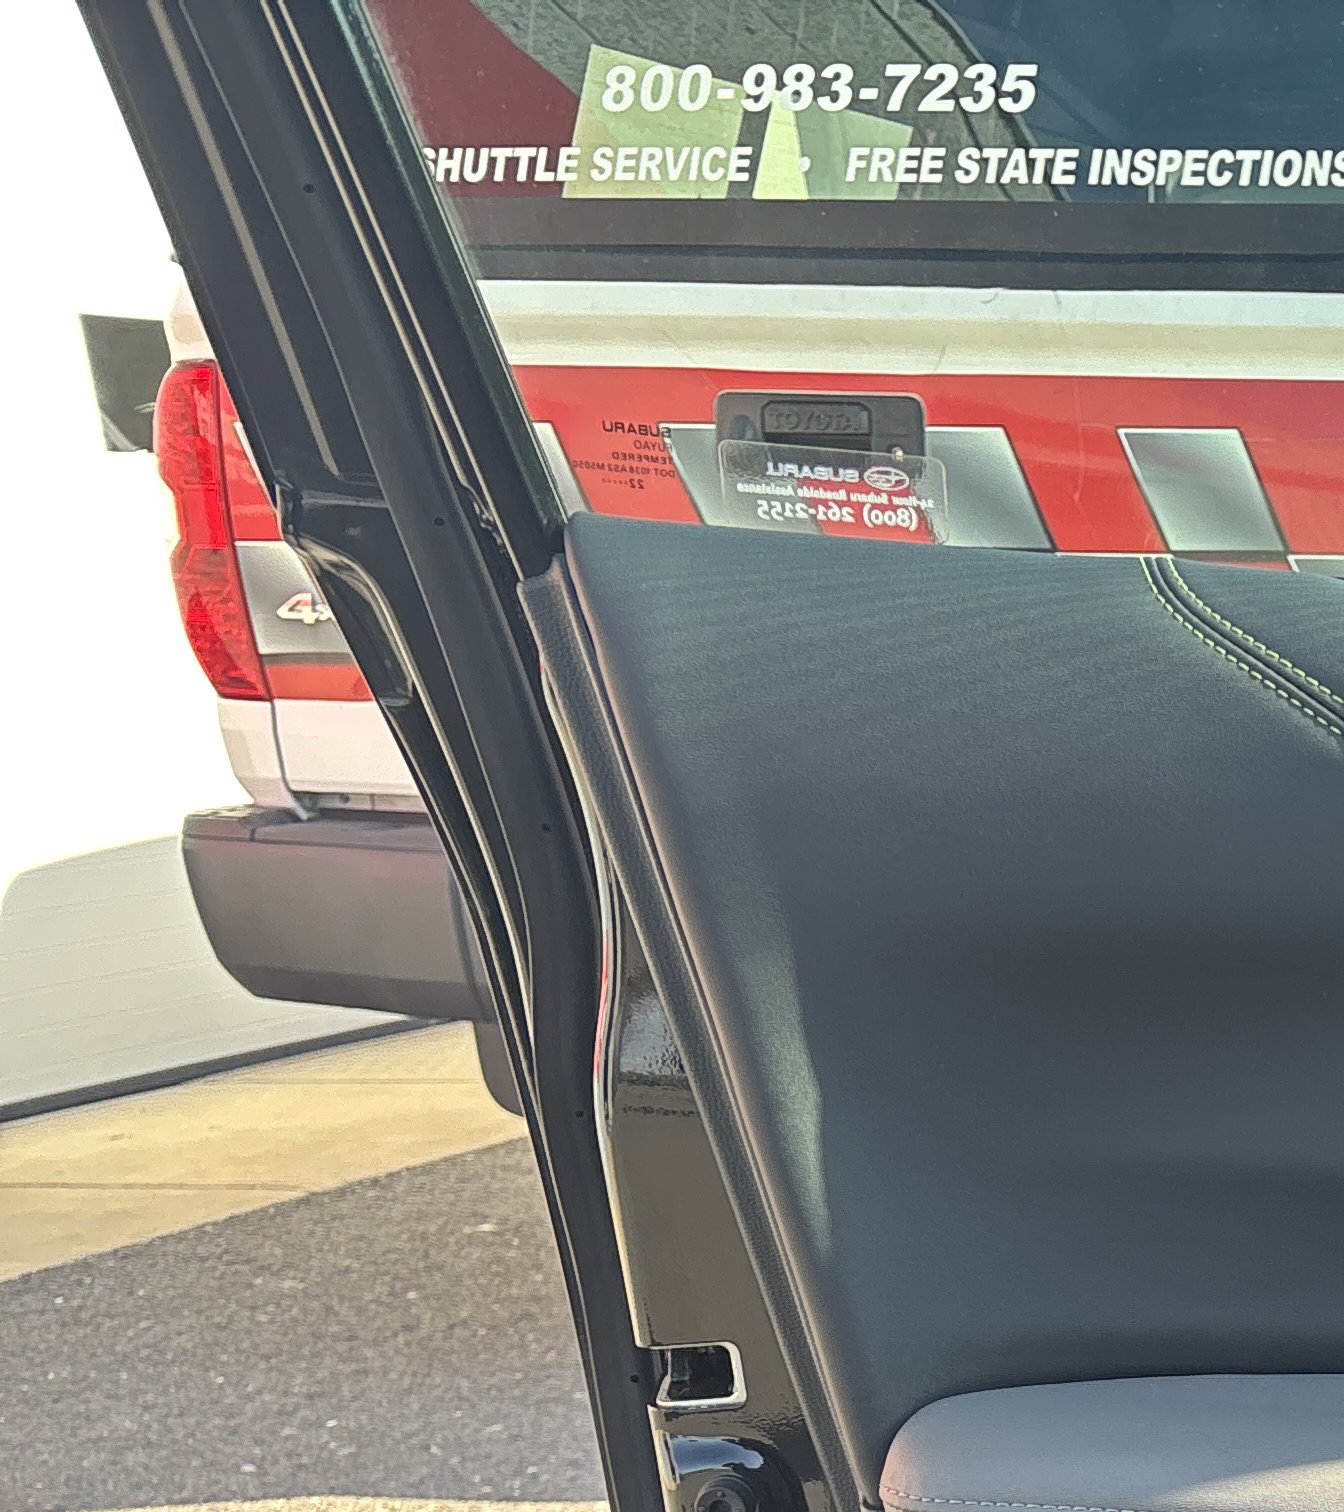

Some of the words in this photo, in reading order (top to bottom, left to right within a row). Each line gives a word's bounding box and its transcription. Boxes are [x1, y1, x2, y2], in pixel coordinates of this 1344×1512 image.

[601, 63, 1038, 113] 800-983-7235
[422, 146, 581, 184] SHUTTLE
[591, 146, 754, 184] SERVICE
[845, 147, 947, 185] FREE
[954, 147, 1080, 186] STATE
